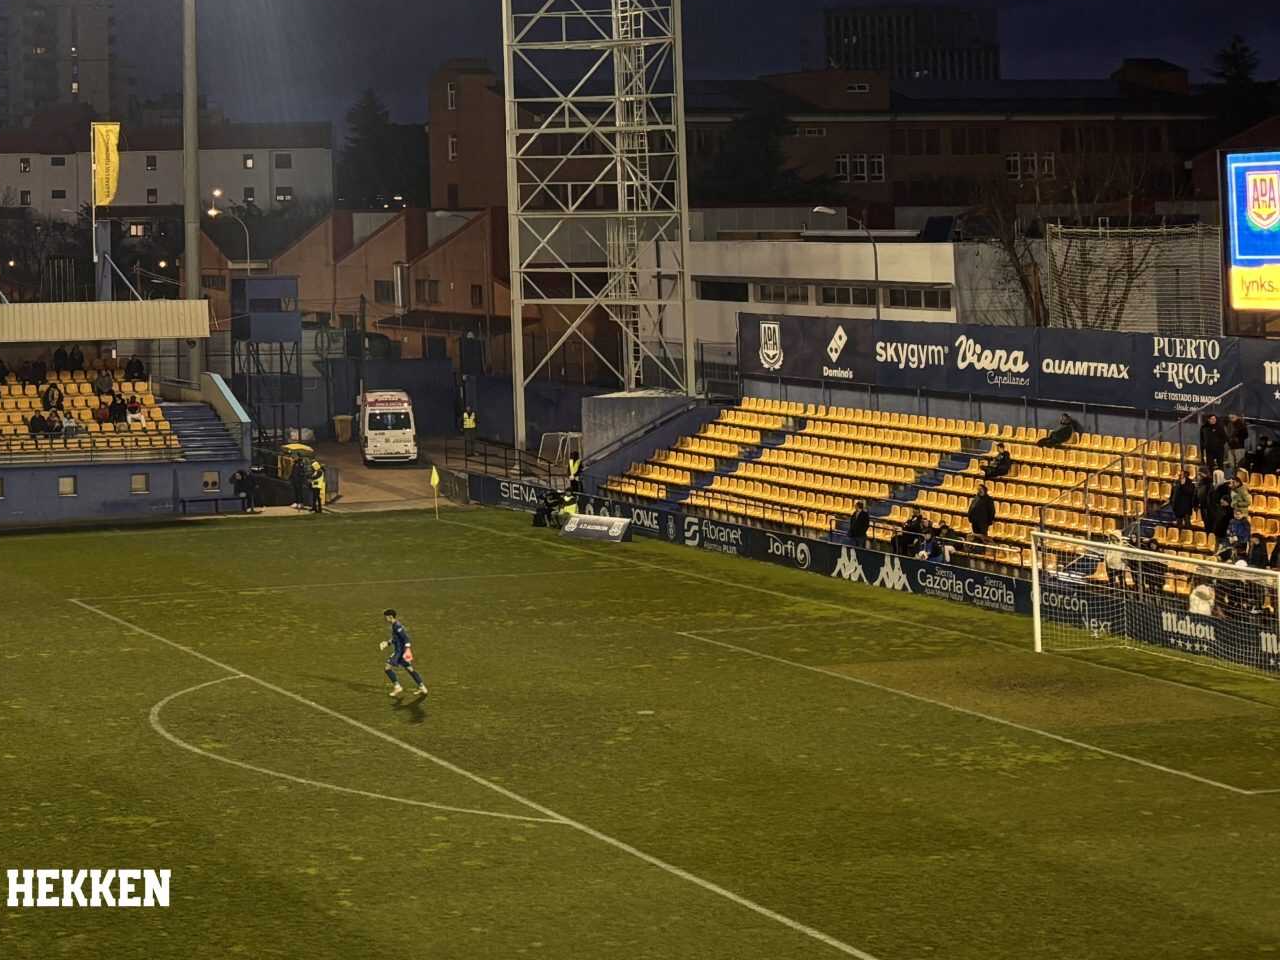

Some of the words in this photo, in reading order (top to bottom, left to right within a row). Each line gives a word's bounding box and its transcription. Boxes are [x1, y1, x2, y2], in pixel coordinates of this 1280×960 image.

[955, 334, 1030, 374] Viena
[1152, 336, 1220, 361] PUERTO
[1041, 358, 1130, 380] QUAMTRAX
[1165, 362, 1207, 389] RICO
[500, 482, 538, 504] SIENA
[702, 520, 743, 545] fibranet
[917, 568, 963, 594] Cazorla
[965, 578, 1014, 605] Cazorla
[1162, 611, 1216, 640] Mahou
